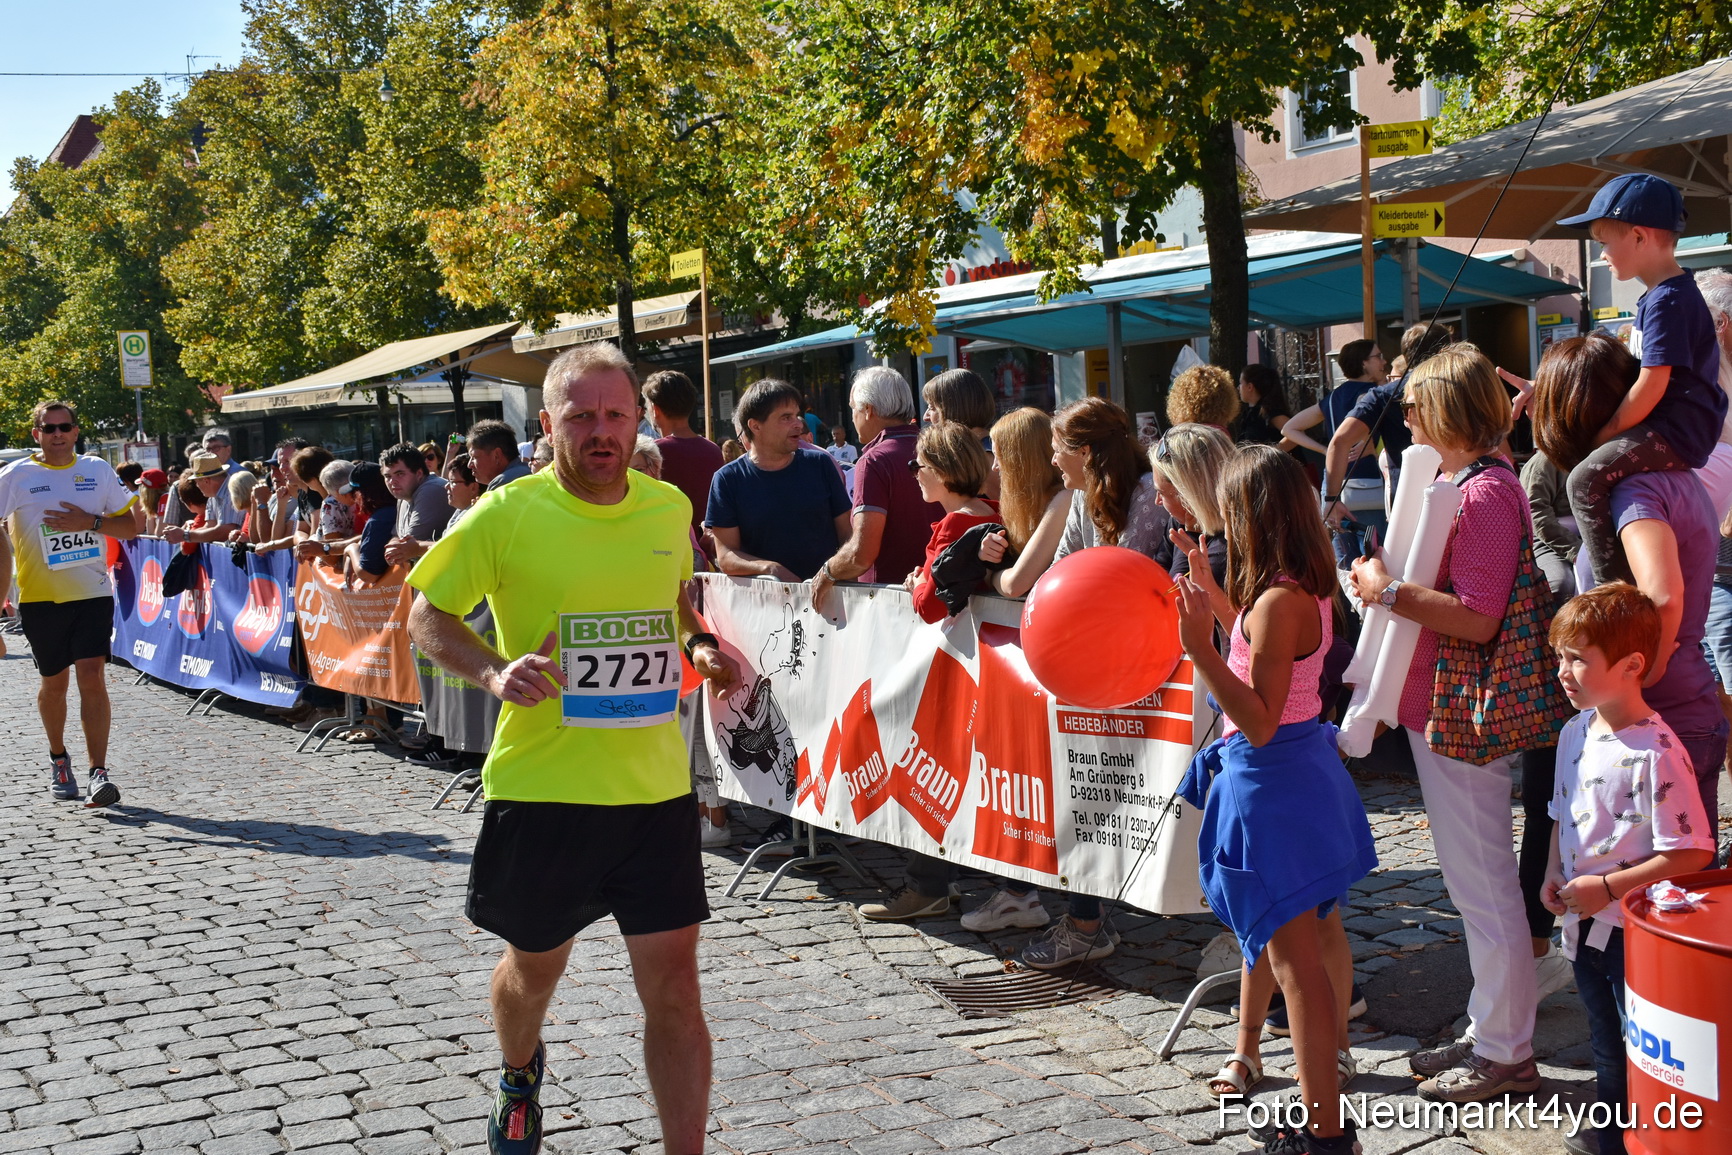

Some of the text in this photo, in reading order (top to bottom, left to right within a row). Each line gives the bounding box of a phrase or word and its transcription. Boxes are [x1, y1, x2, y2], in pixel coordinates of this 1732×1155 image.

[1377, 143, 1408, 155] ausgabe
[1378, 210, 1429, 221] Kleiderbeutel-
[1388, 222, 1419, 233] ausgabe
[675, 257, 701, 271] Toiletten
[50, 532, 95, 552] 2644
[60, 551, 90, 561] DIETER
[571, 614, 670, 645] BOCK
[577, 650, 668, 688] 2727
[595, 699, 647, 717] Stefan
[1064, 715, 1145, 735] HEBEBÄNDER
[1068, 748, 1135, 768] Braun GmbH
[842, 751, 884, 801] Braun
[895, 728, 960, 811] Braun
[1070, 767, 1145, 790] Am Grünberg 8
[974, 751, 1046, 824] Braun
[1070, 784, 1111, 802] D-92318
[909, 786, 949, 828] Sicher ist sicher
[1072, 810, 1092, 826] Tel.
[1094, 812, 1121, 828] 09181
[1130, 817, 1155, 834] 2307-0
[1003, 821, 1056, 848] Sicher ist sicher
[1075, 827, 1094, 843] Fax
[1096, 830, 1122, 848] 09181
[1627, 1004, 1685, 1072] ÖDL
